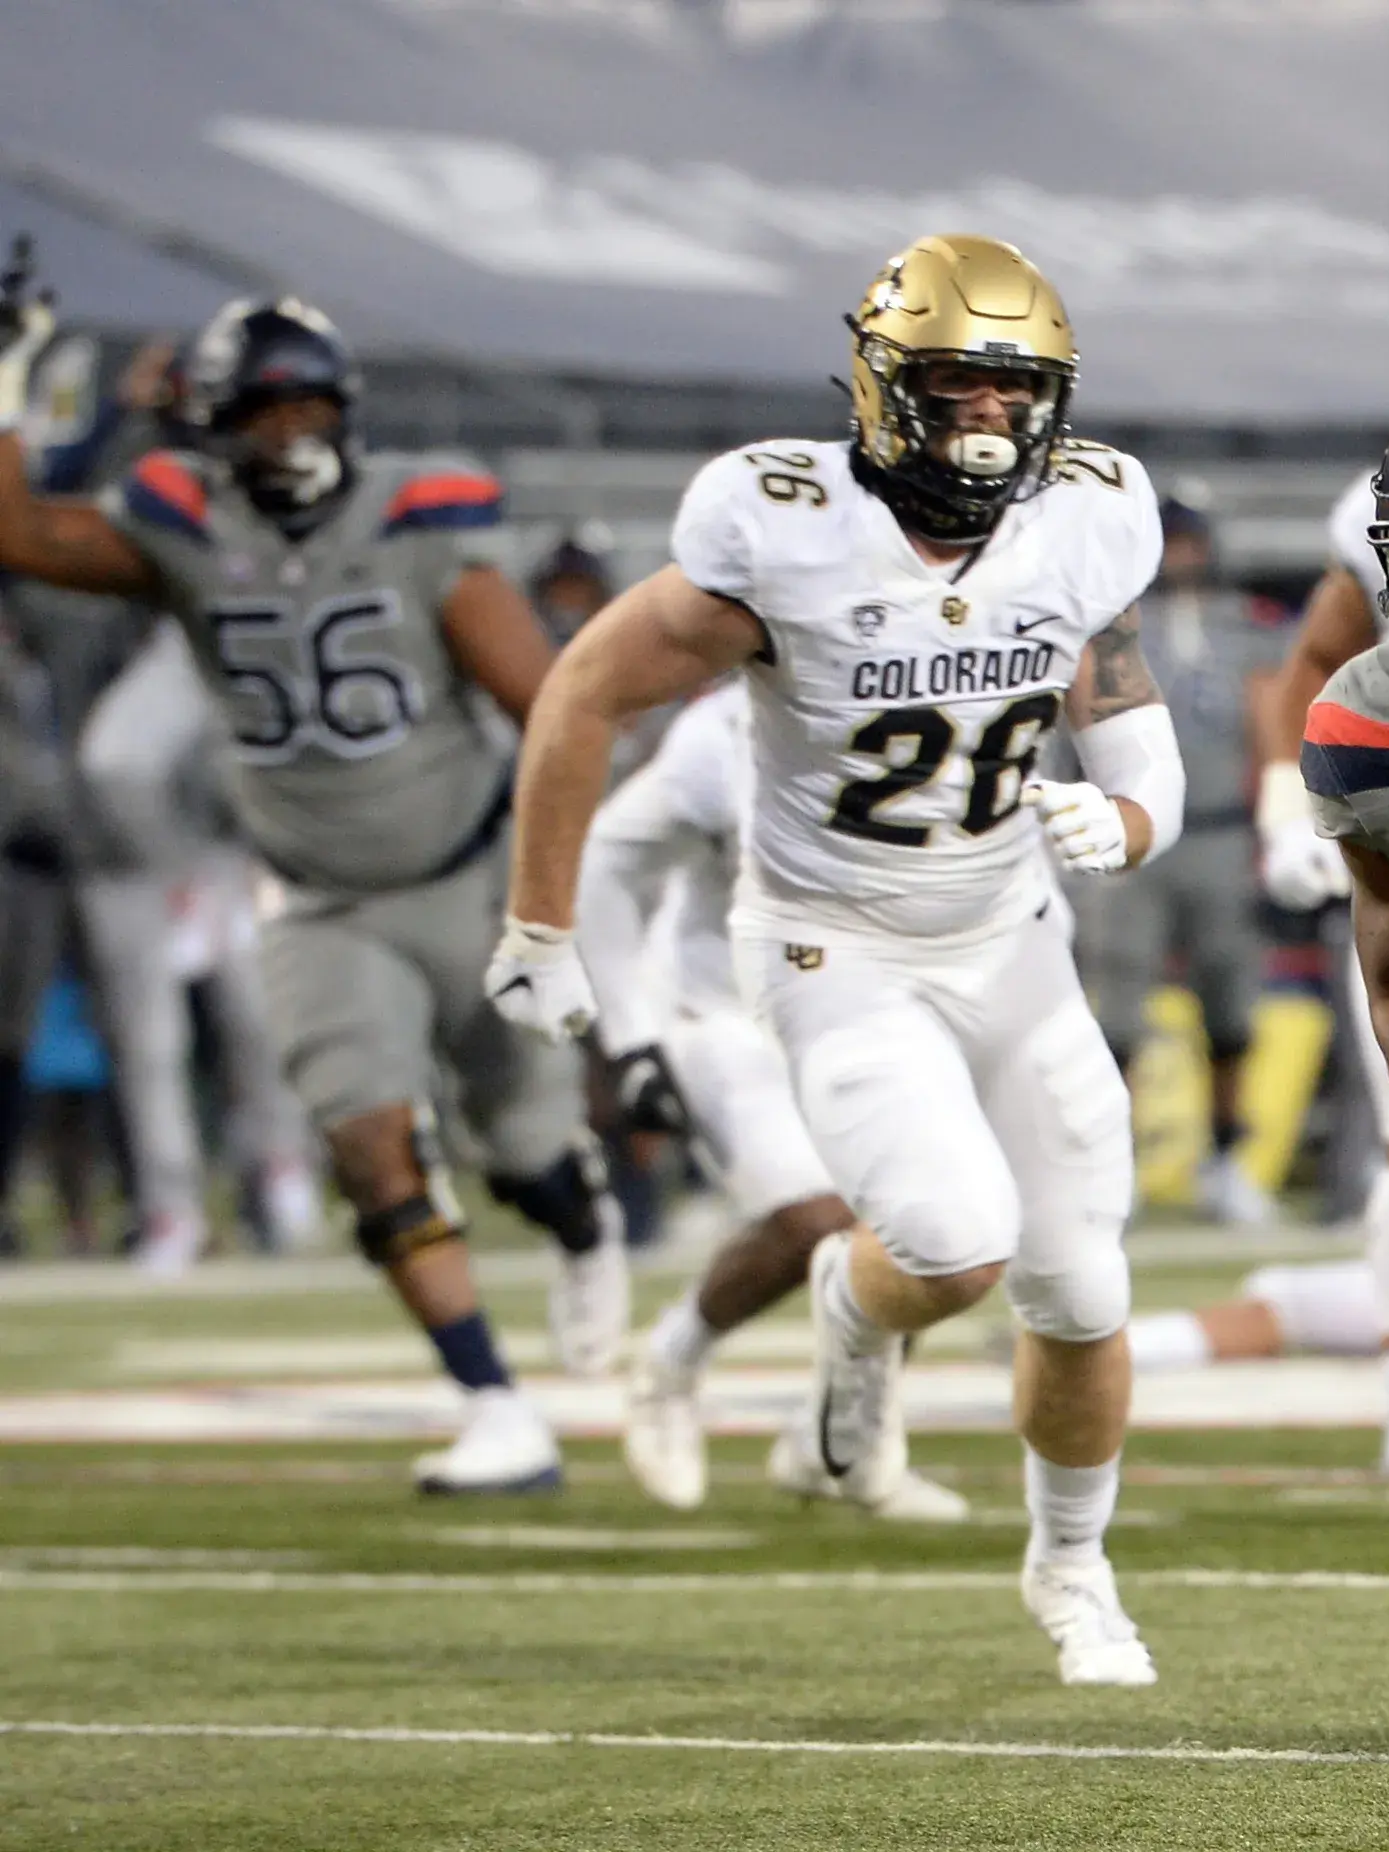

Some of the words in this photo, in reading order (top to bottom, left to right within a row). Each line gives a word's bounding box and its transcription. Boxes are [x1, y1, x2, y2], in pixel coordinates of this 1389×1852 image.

[744, 451, 828, 507] 26
[205, 589, 424, 765] 56
[852, 643, 1055, 699] COLORADO
[828, 688, 1062, 848] 26
